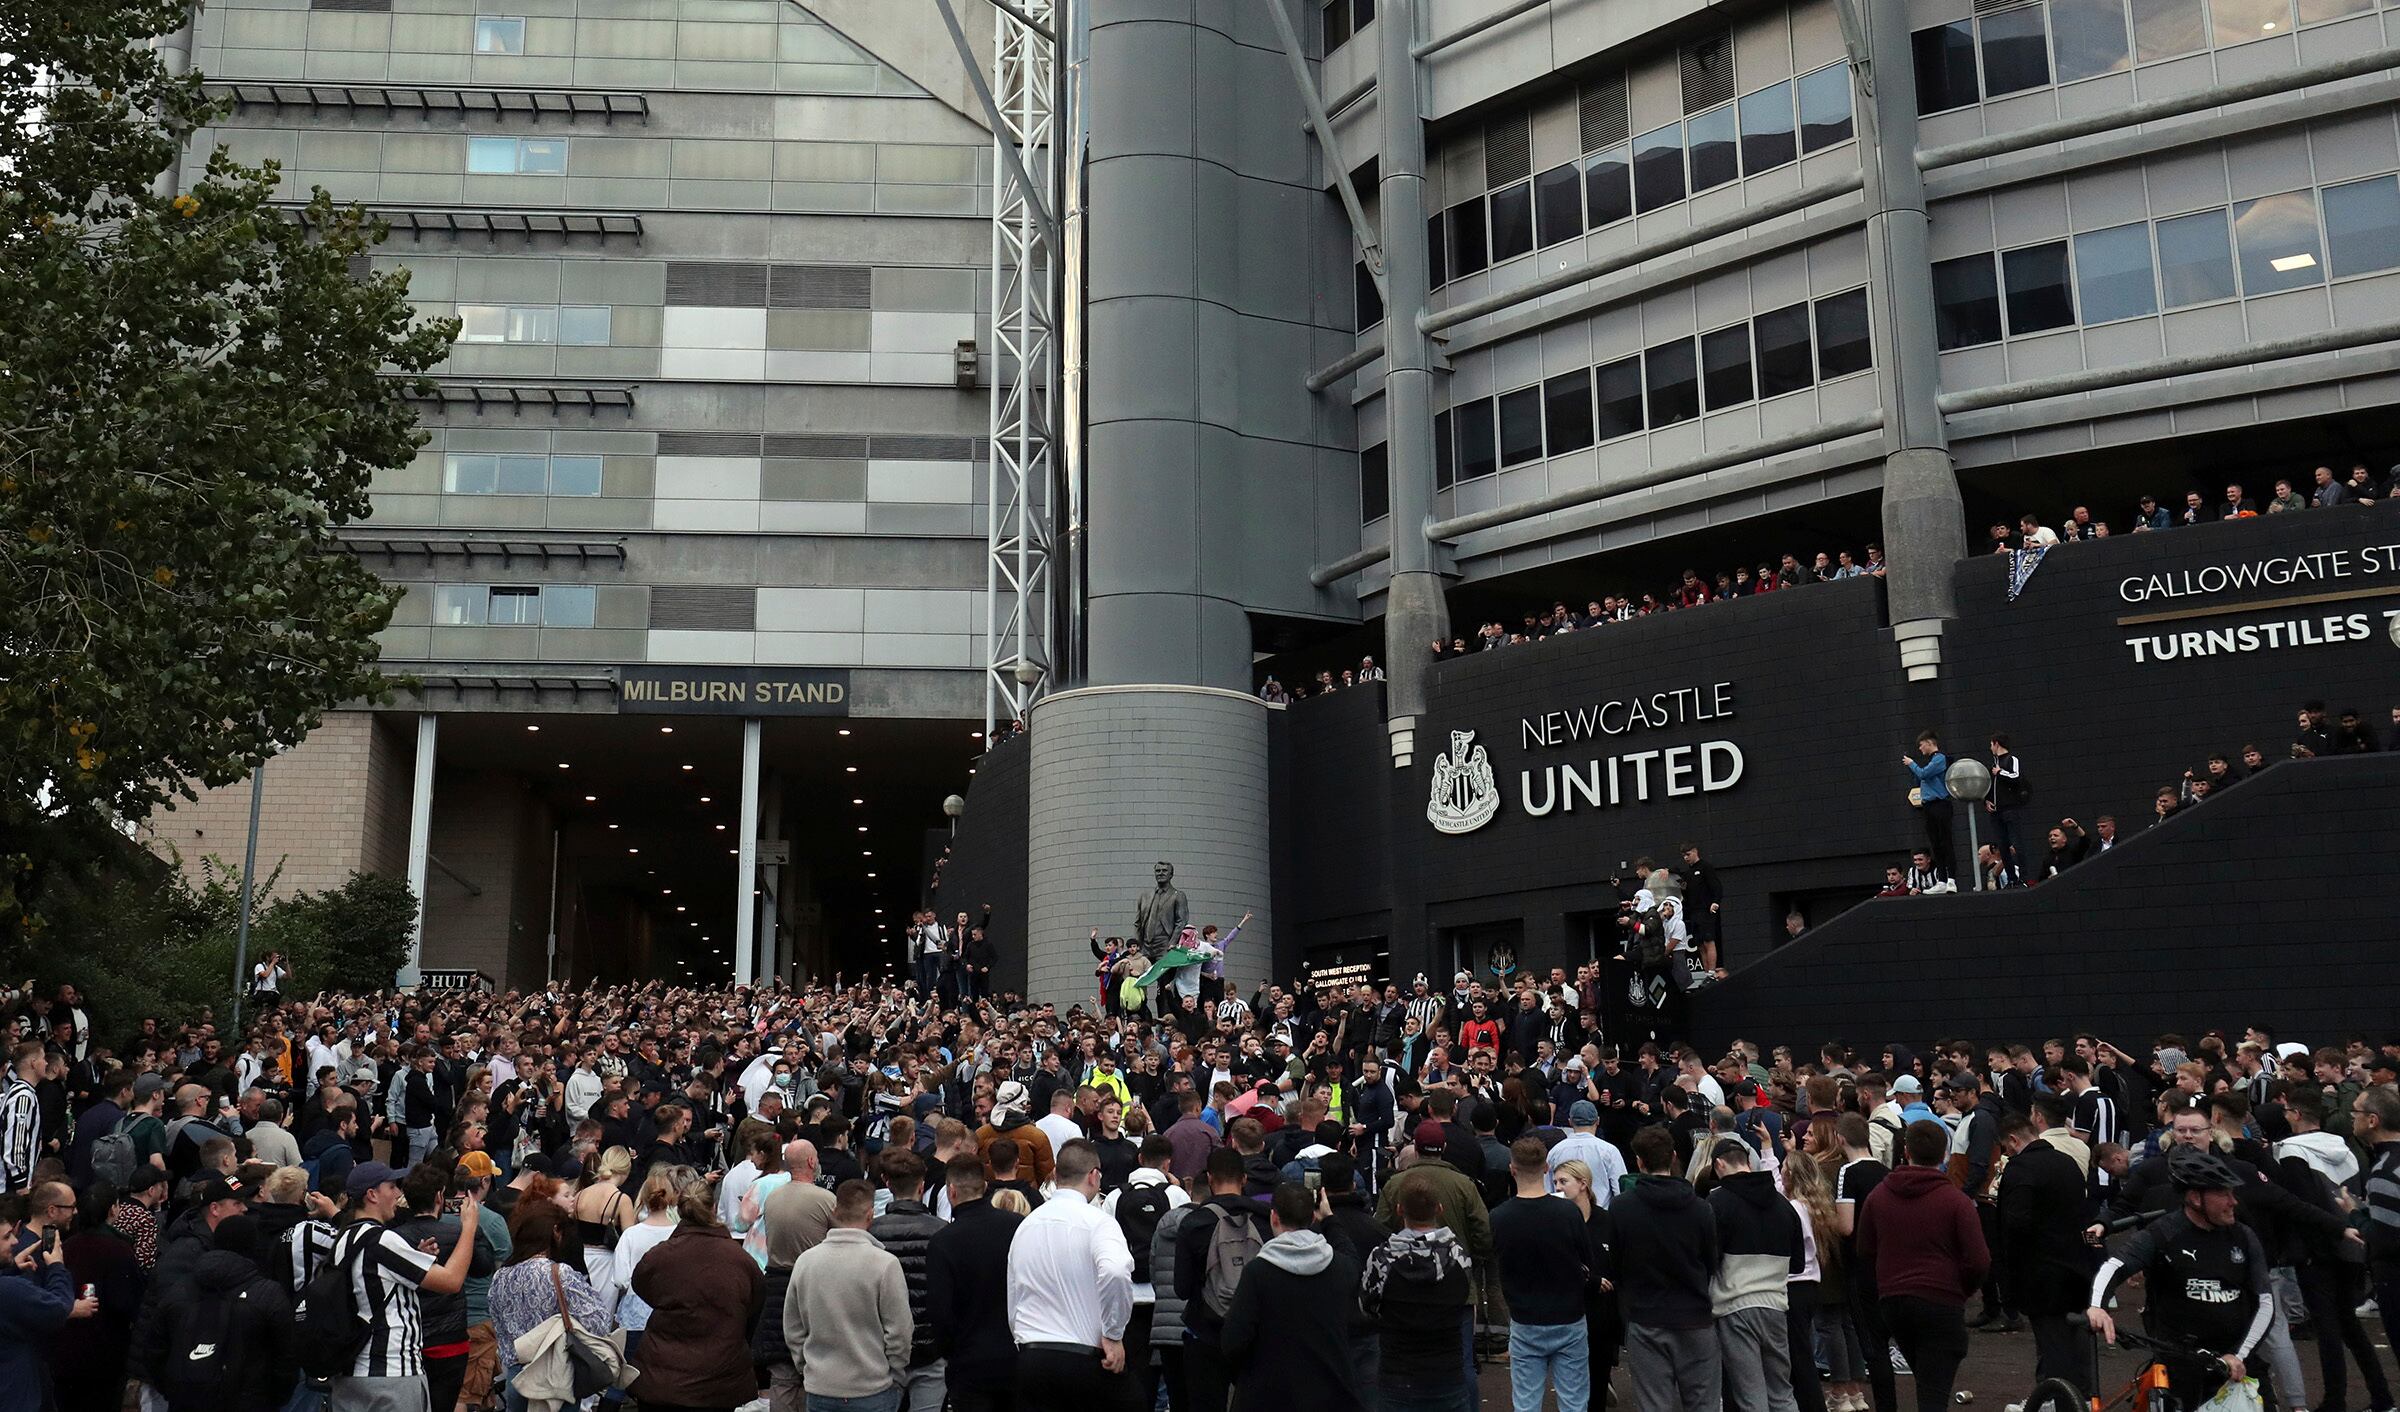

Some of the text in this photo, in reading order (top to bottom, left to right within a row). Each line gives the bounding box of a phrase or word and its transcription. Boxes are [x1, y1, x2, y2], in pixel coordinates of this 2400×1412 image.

[2119, 544, 2400, 602] GALLOWGATE ST
[2125, 613, 2371, 663] TURNSTILES
[624, 680, 844, 703] MILBURN STAND
[1522, 682, 1733, 749] NEWCASTLE
[1521, 740, 1744, 816] UNITED
[1439, 809, 1490, 828] NEWCASTLE UNITED
[1311, 963, 1371, 978] SOUTH WEST RECEPTION
[431, 975, 468, 988] HUT
[1315, 977, 1348, 988] GALLOWGATE
[194, 1343, 217, 1354] NIKE
